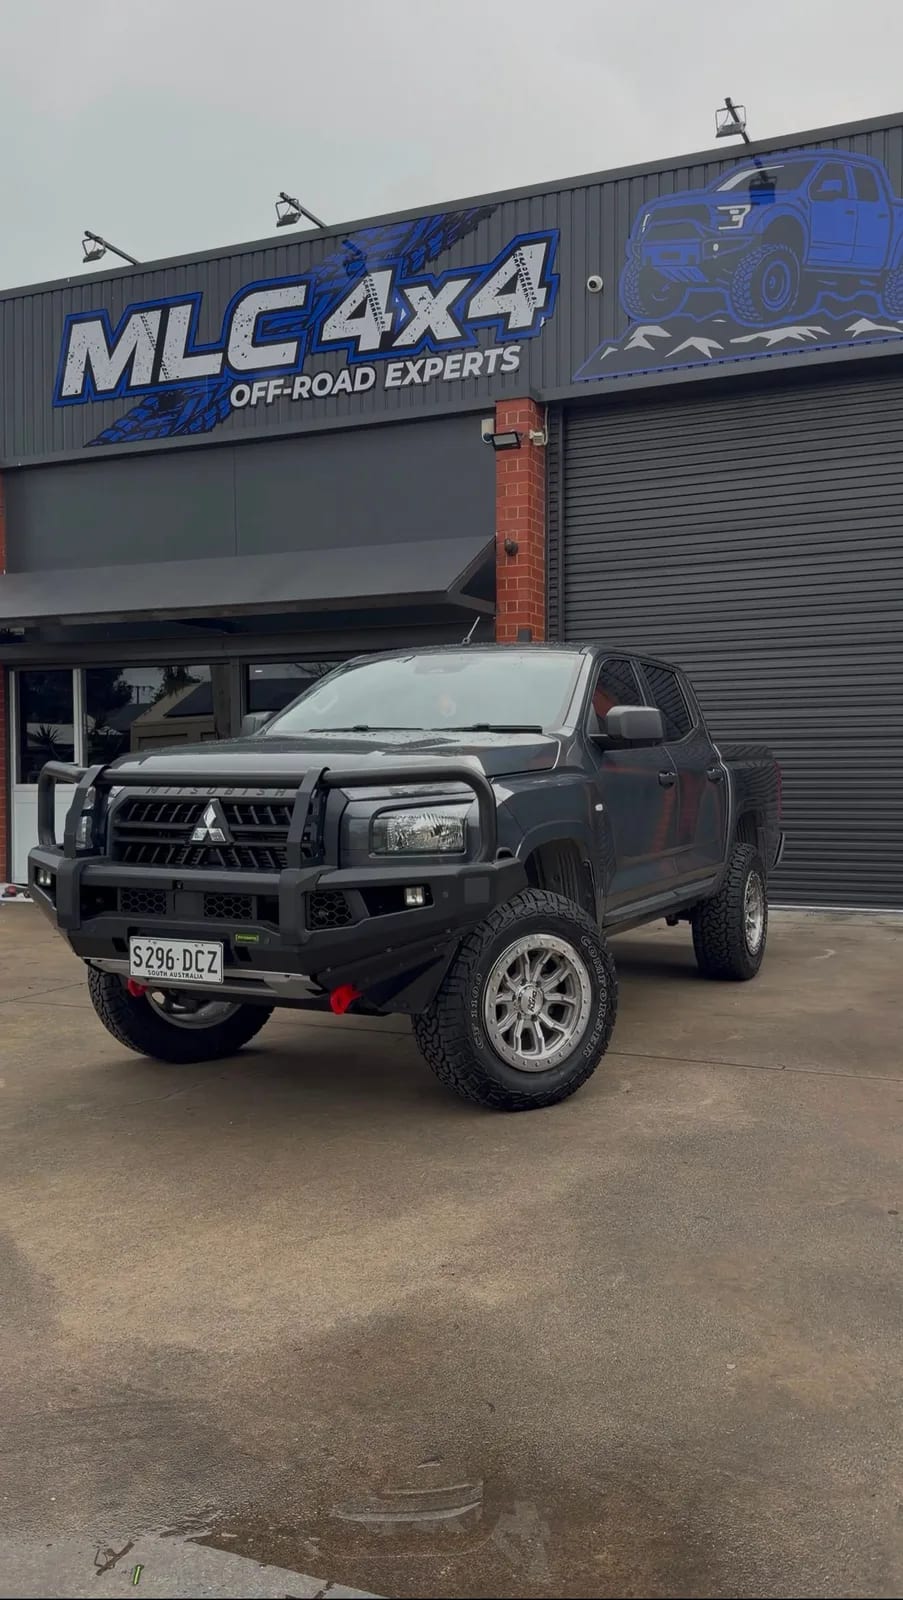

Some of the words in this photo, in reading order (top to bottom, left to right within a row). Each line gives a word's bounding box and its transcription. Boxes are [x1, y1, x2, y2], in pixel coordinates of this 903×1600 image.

[62, 284, 307, 397] MLC
[321, 242, 547, 351] 4x4
[229, 366, 376, 408] OFF-ROAD
[384, 345, 521, 388] EXPERTS
[145, 785, 288, 797] MITSUBISH
[147, 969, 168, 977] SOUTH
[169, 971, 204, 980] AUSTRALIA
